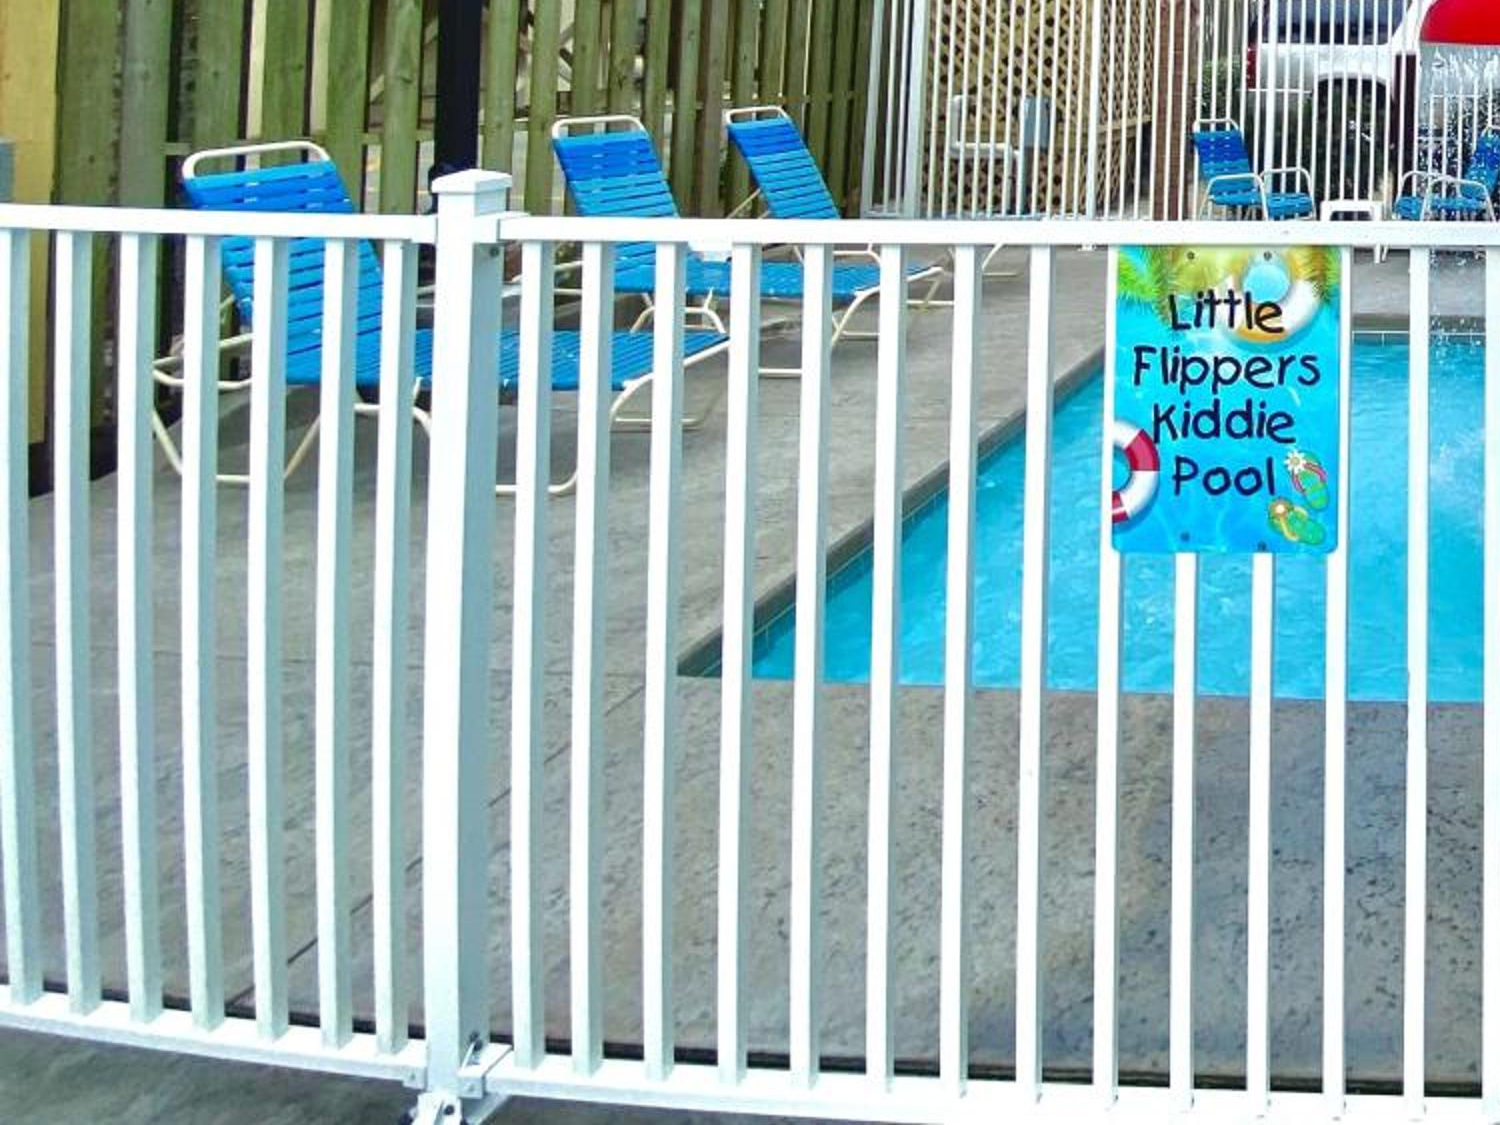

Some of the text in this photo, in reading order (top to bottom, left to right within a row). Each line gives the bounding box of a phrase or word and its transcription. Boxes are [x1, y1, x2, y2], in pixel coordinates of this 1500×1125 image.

[1168, 289, 1285, 333] Little
[1133, 345, 1321, 395] Flippers
[1153, 398, 1297, 444] Kiddie
[1172, 455, 1276, 497] Pool
